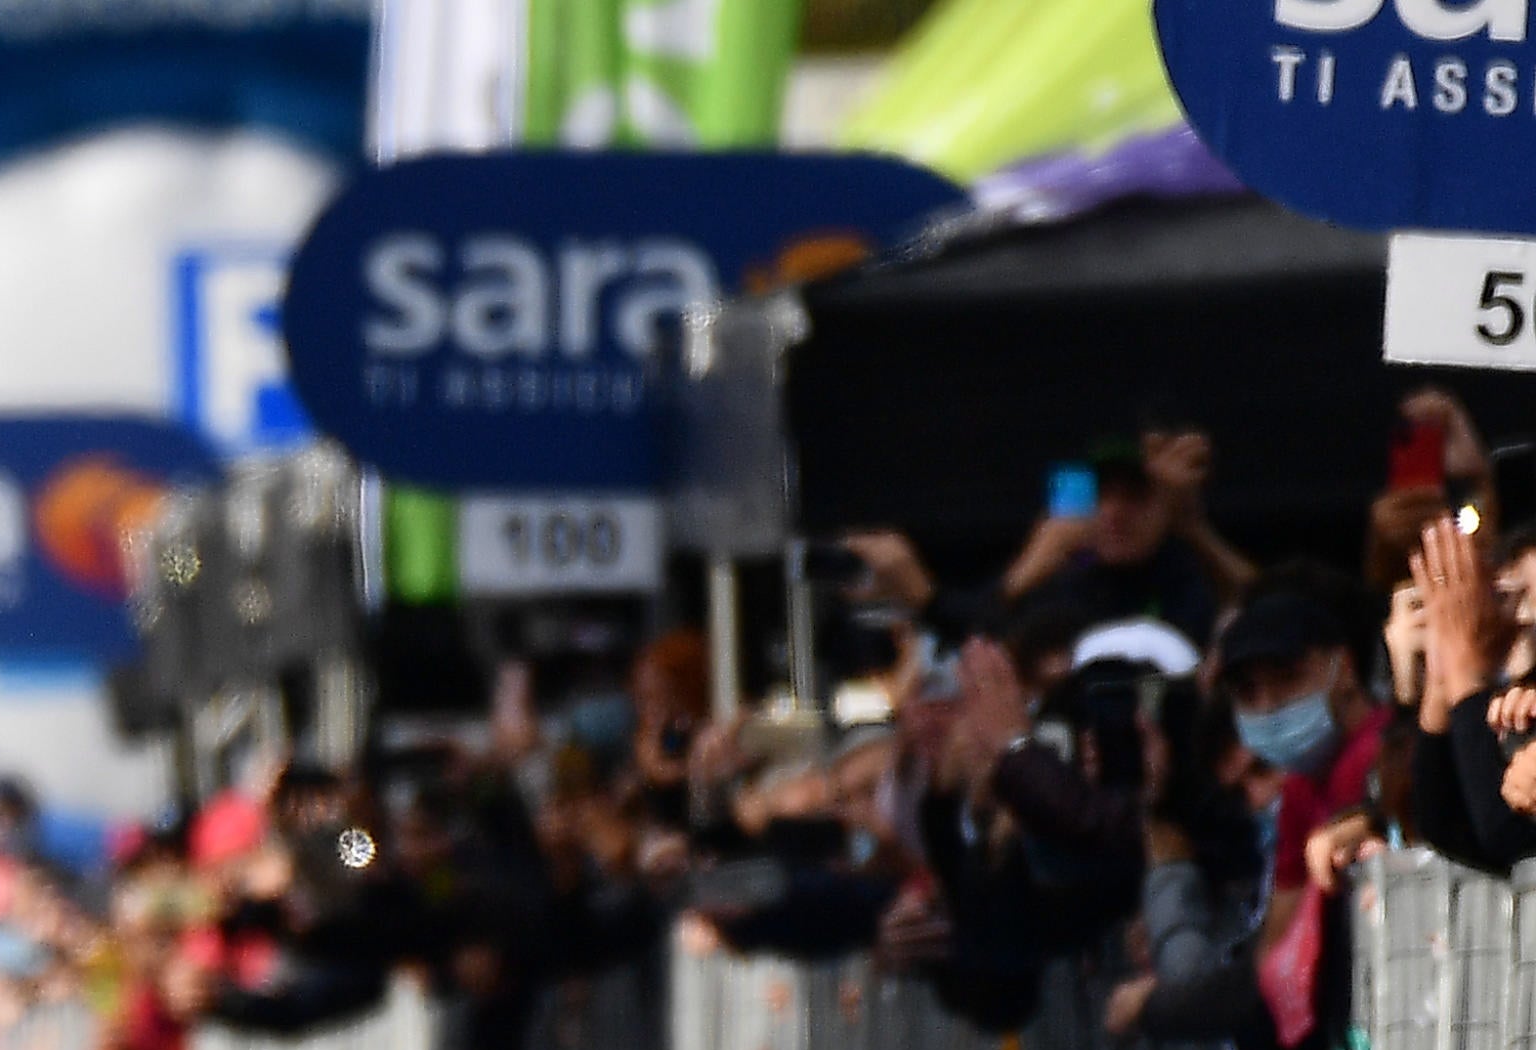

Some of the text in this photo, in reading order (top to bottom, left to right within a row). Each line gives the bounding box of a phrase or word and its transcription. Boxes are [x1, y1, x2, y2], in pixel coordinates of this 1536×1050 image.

[1272, 47, 1536, 116] TI ASS
[363, 231, 718, 361] sara
[1475, 270, 1536, 347] 5
[500, 512, 623, 567] 100
